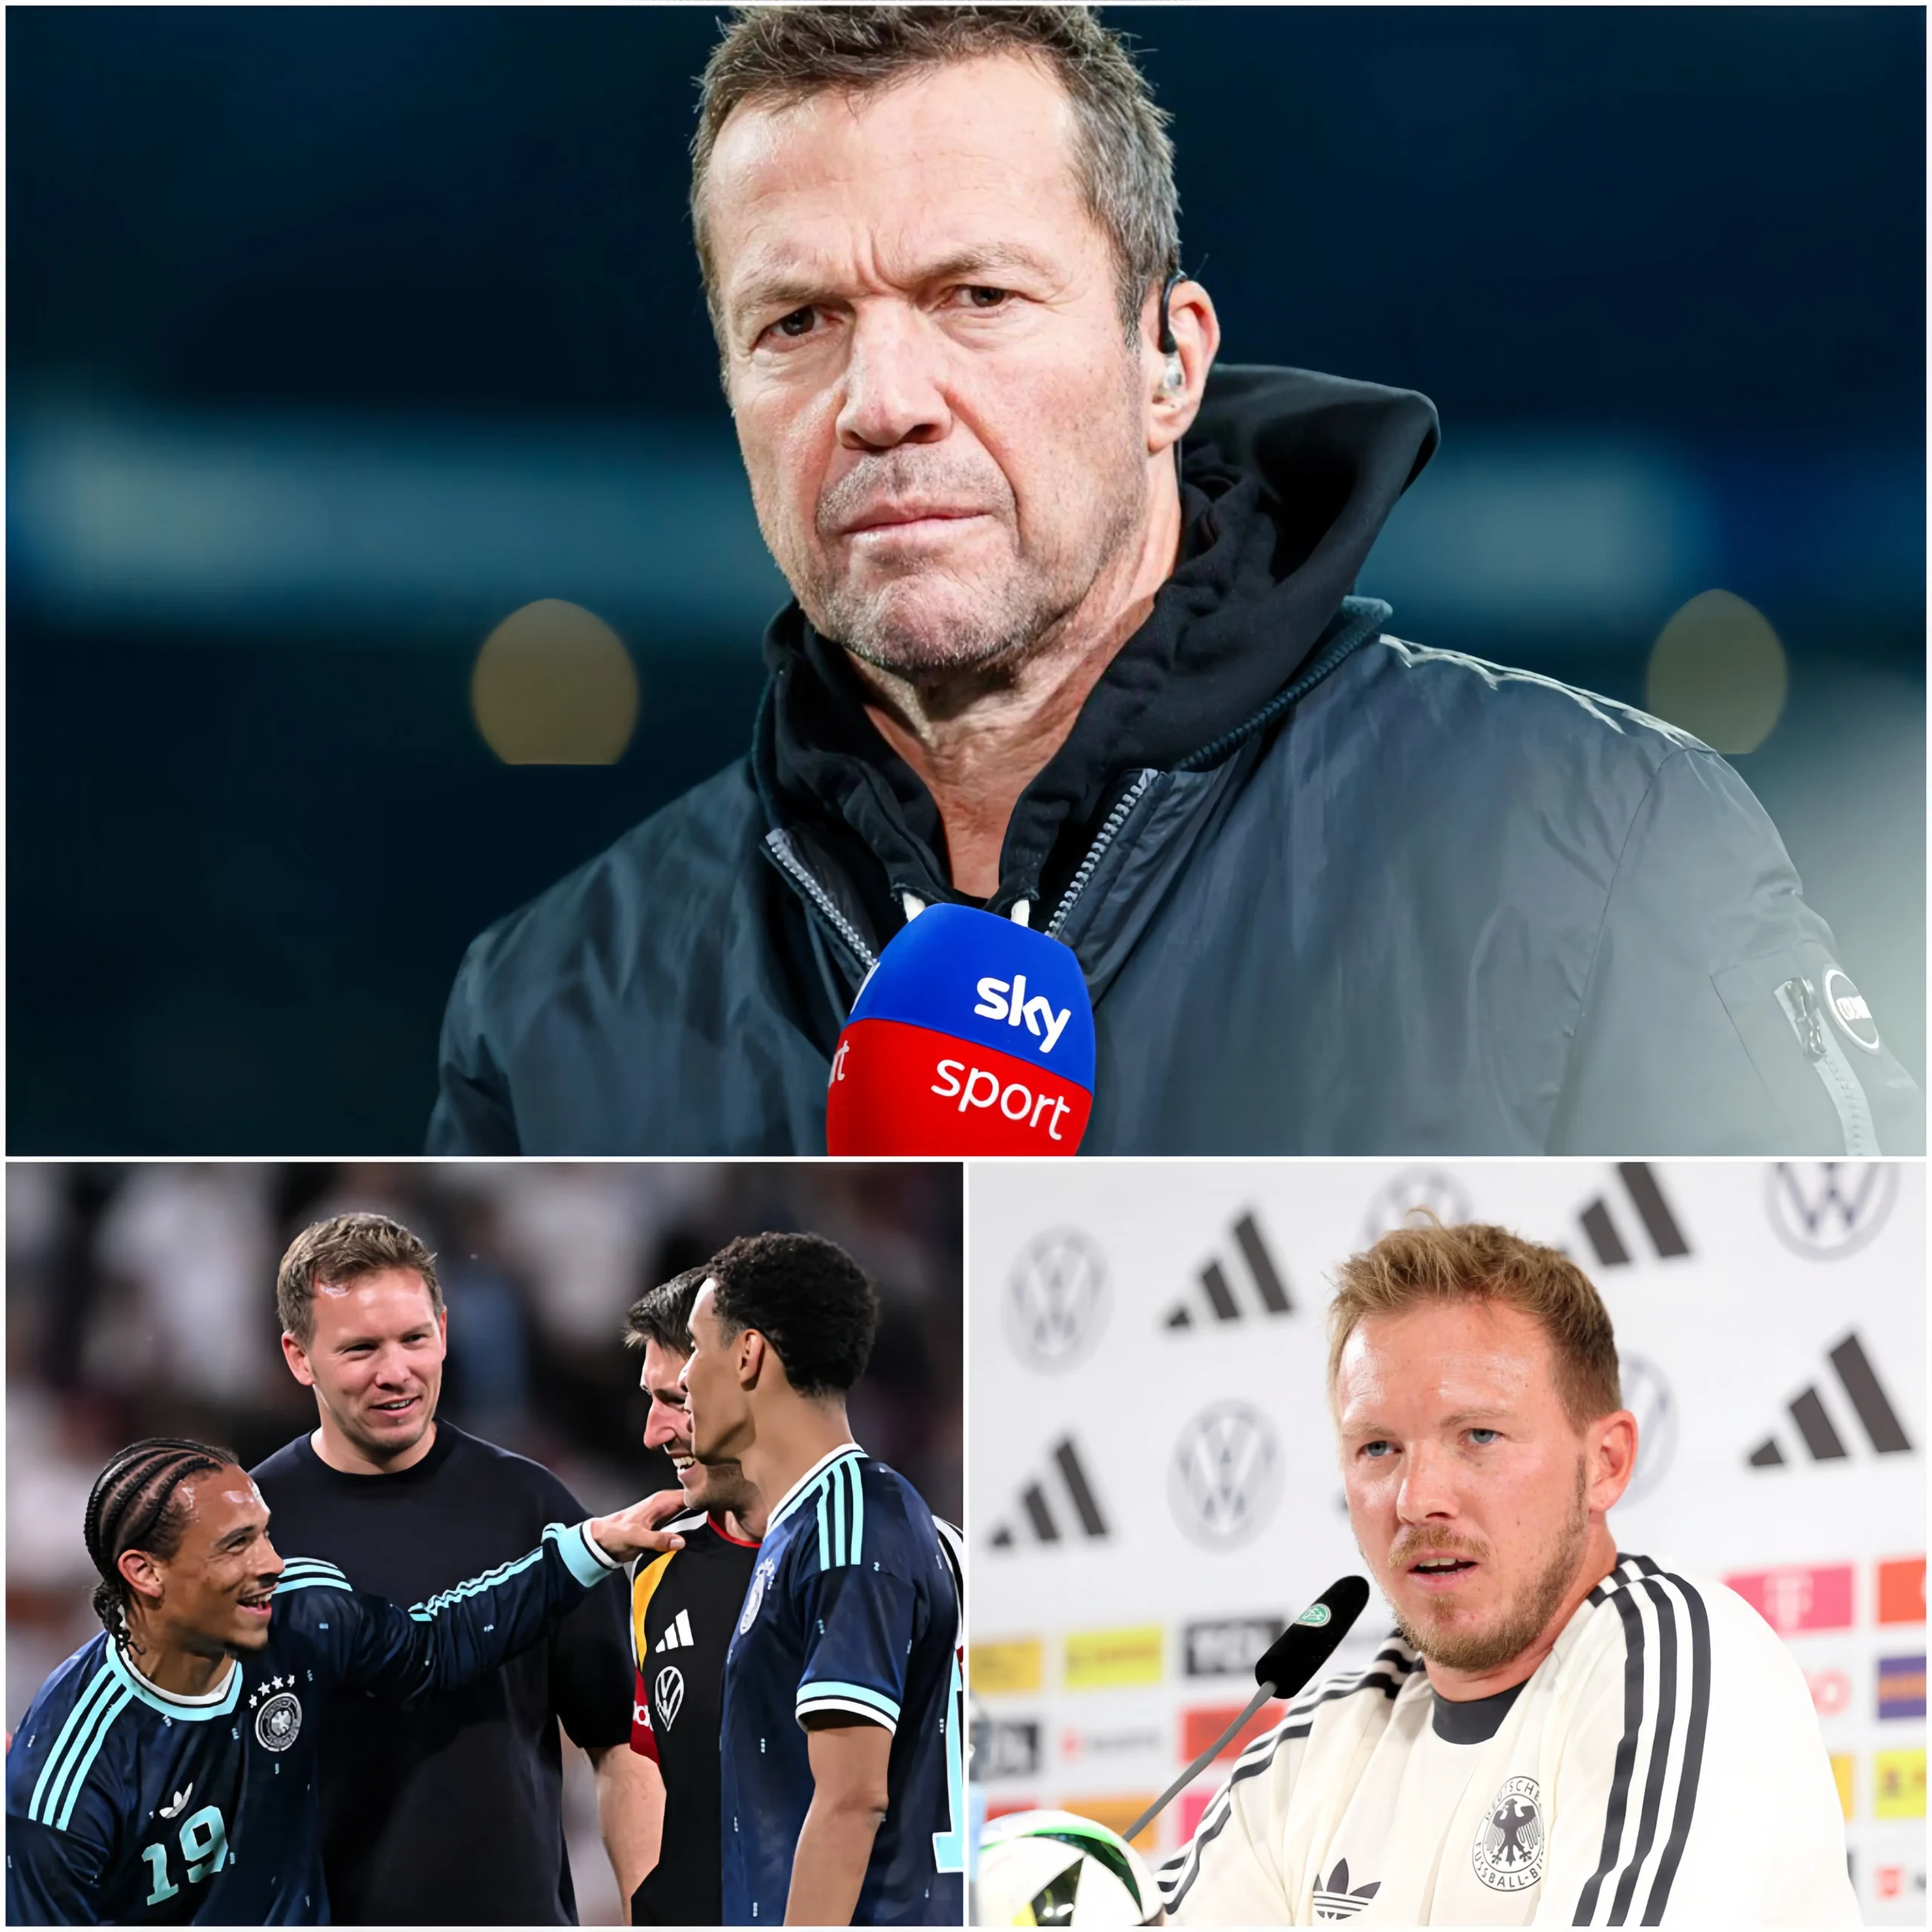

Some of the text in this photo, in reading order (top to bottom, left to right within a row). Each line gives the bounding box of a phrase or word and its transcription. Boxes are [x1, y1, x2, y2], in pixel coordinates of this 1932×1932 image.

[974, 974, 1072, 1054] sky
[931, 1059, 1071, 1140] sport
[141, 1805, 229, 1906] 19
